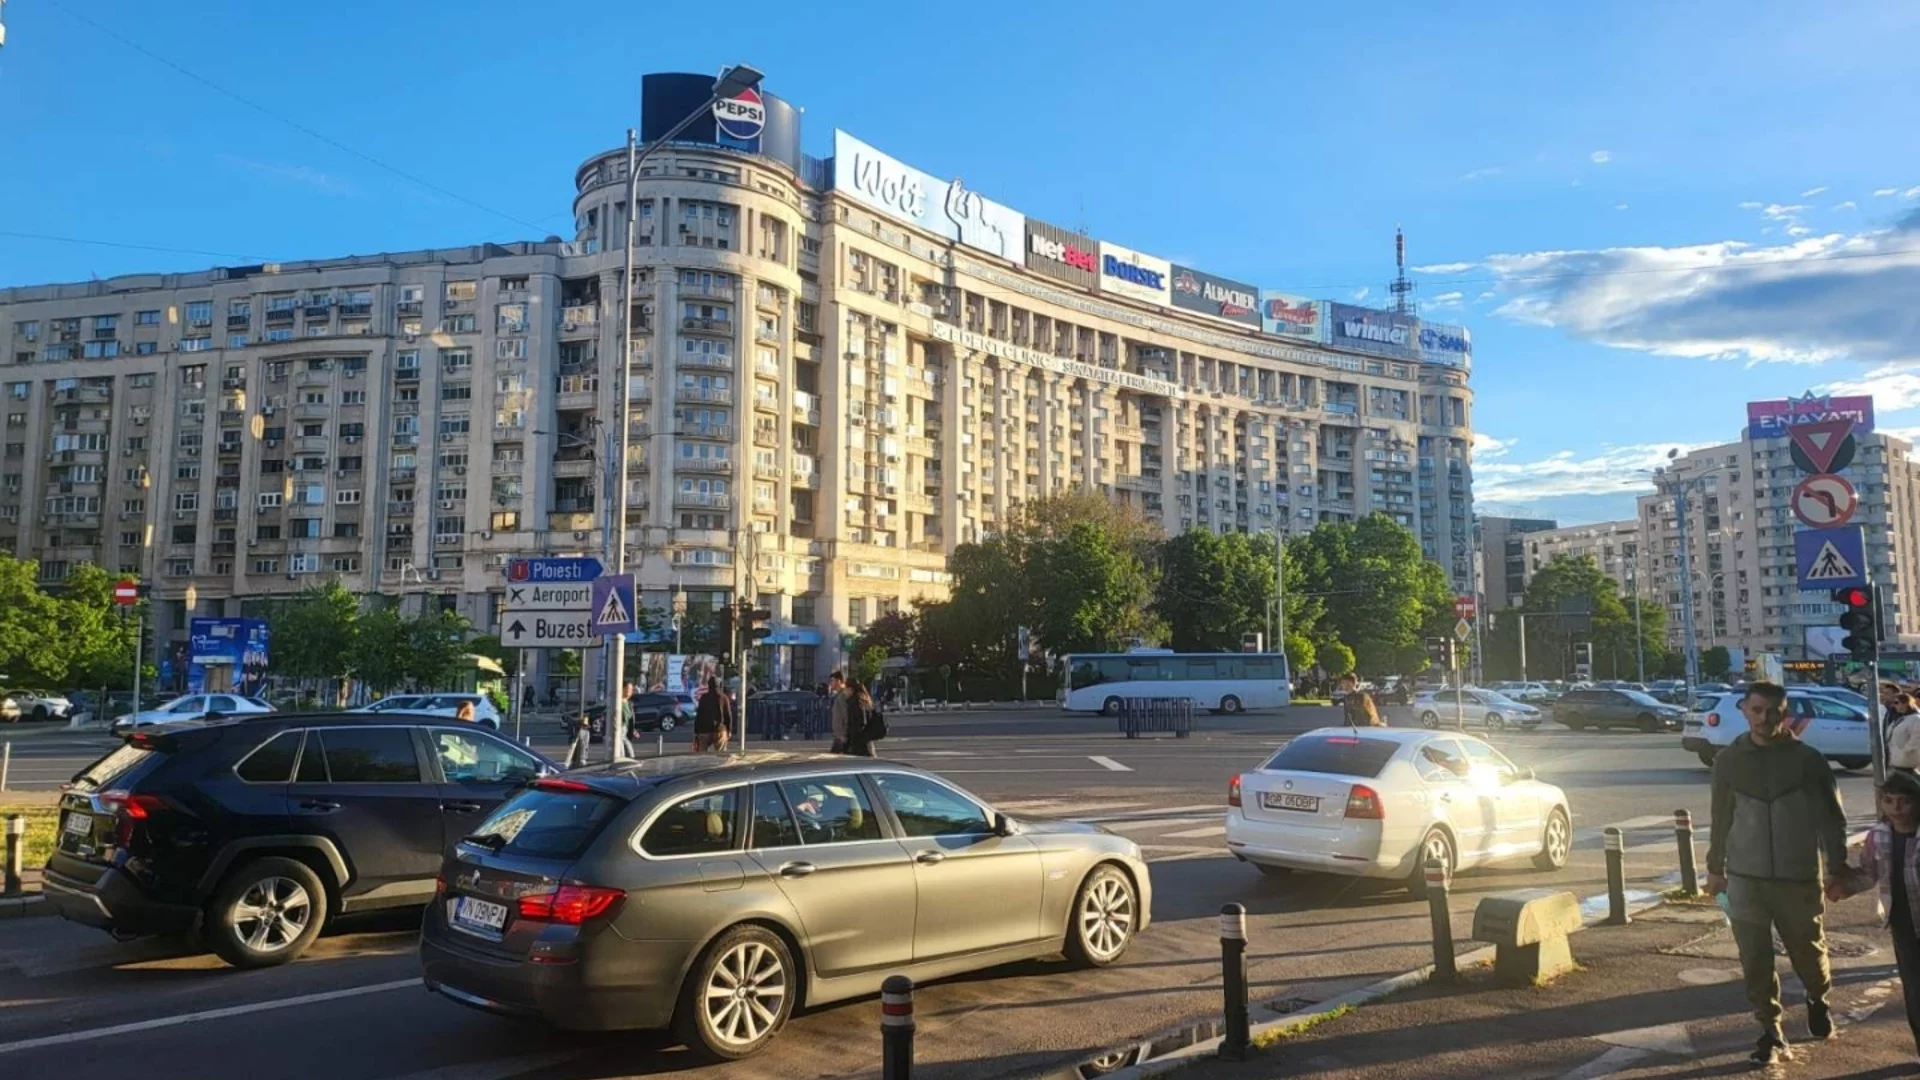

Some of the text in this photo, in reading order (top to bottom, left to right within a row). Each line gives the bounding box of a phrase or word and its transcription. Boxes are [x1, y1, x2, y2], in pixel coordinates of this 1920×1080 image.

[715, 99, 763, 121] PEPSI
[854, 152, 926, 219] Wolt
[1030, 234, 1097, 273] NetBet
[1102, 254, 1165, 291] BORSEC
[1202, 281, 1257, 311] ALBACHER
[1343, 316, 1408, 345] winner
[532, 586, 590, 606] Aeroport
